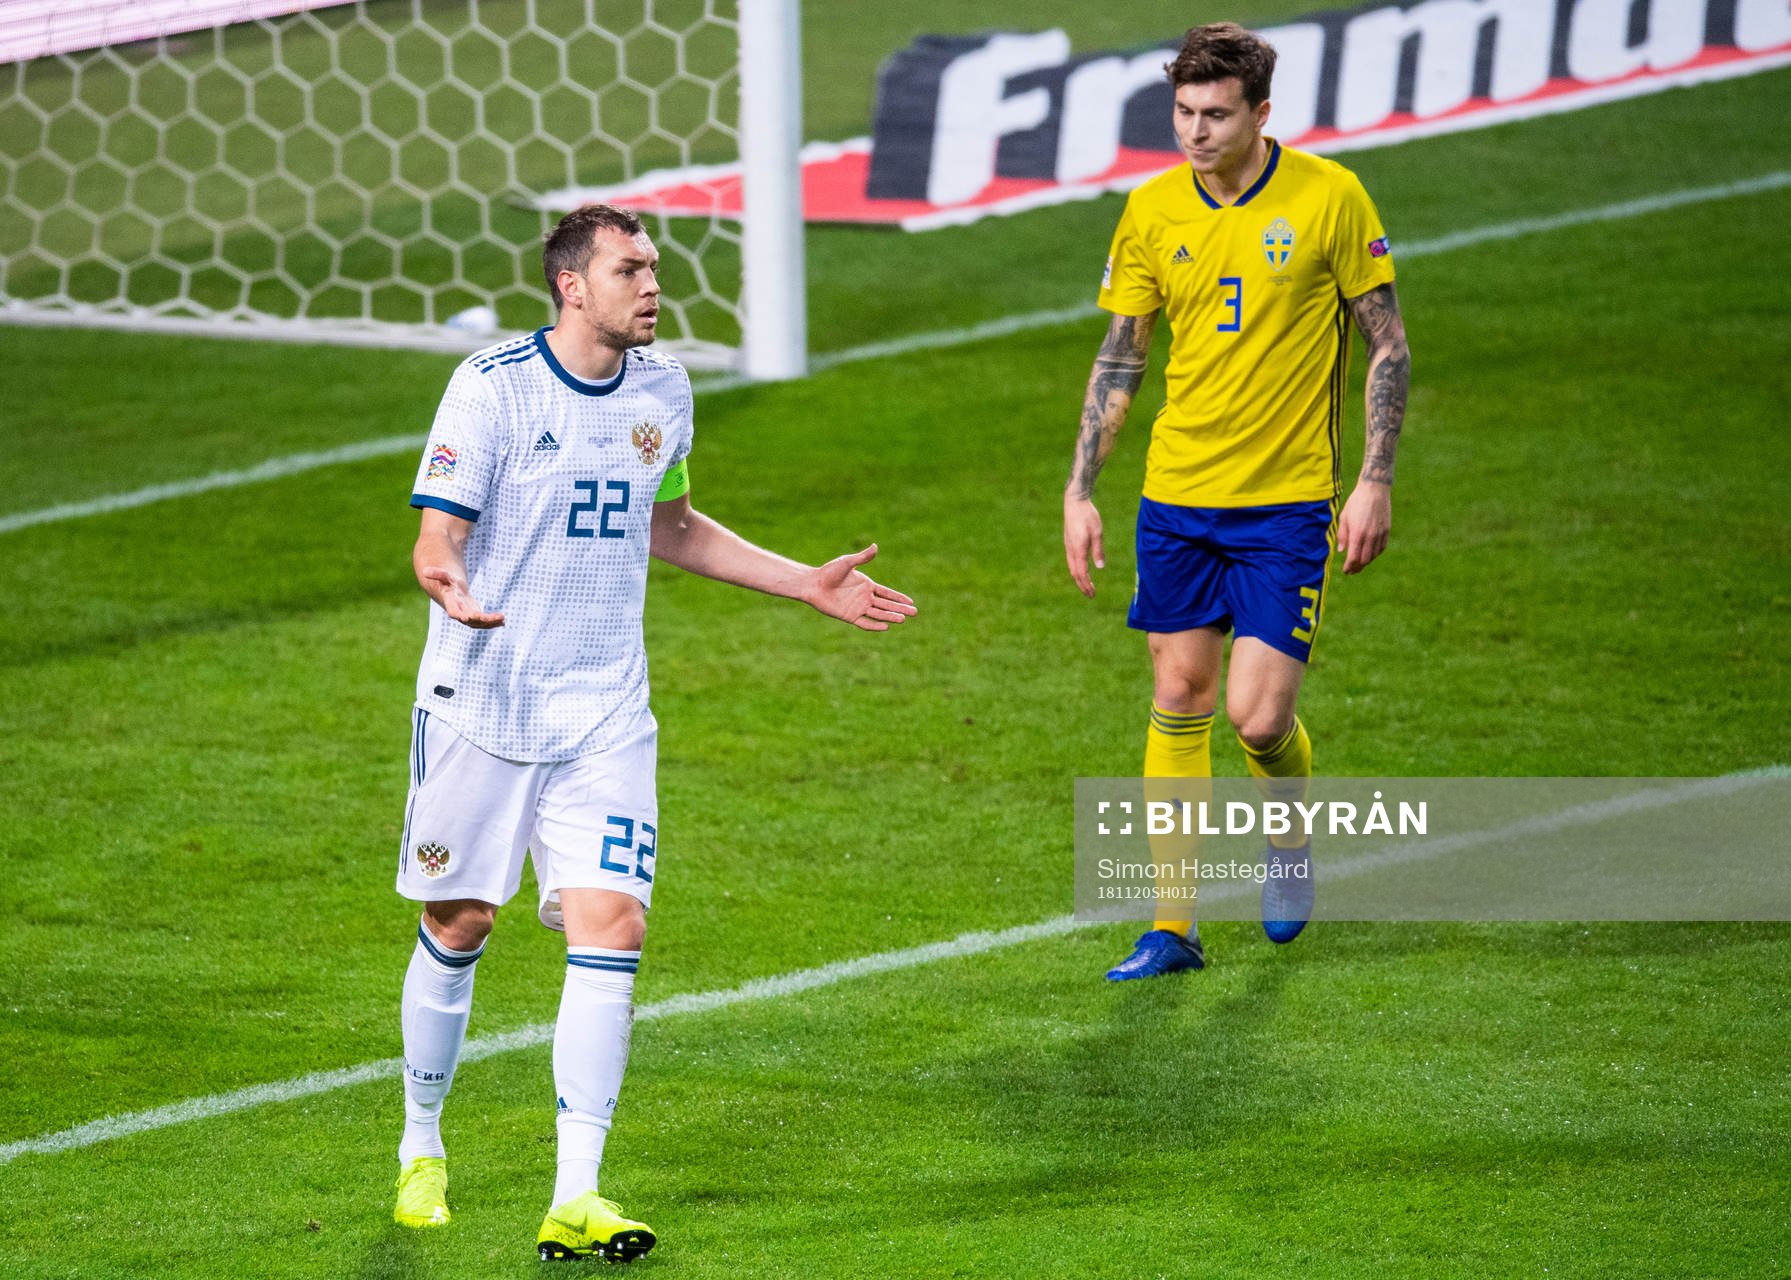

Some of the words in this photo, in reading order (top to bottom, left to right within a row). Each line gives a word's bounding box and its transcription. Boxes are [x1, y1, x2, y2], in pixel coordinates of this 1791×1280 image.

[1217, 277, 1242, 332] 3
[533, 443, 560, 451] adidas
[566, 480, 630, 538] 22
[1291, 586, 1319, 644] 3
[600, 815, 657, 884] 22
